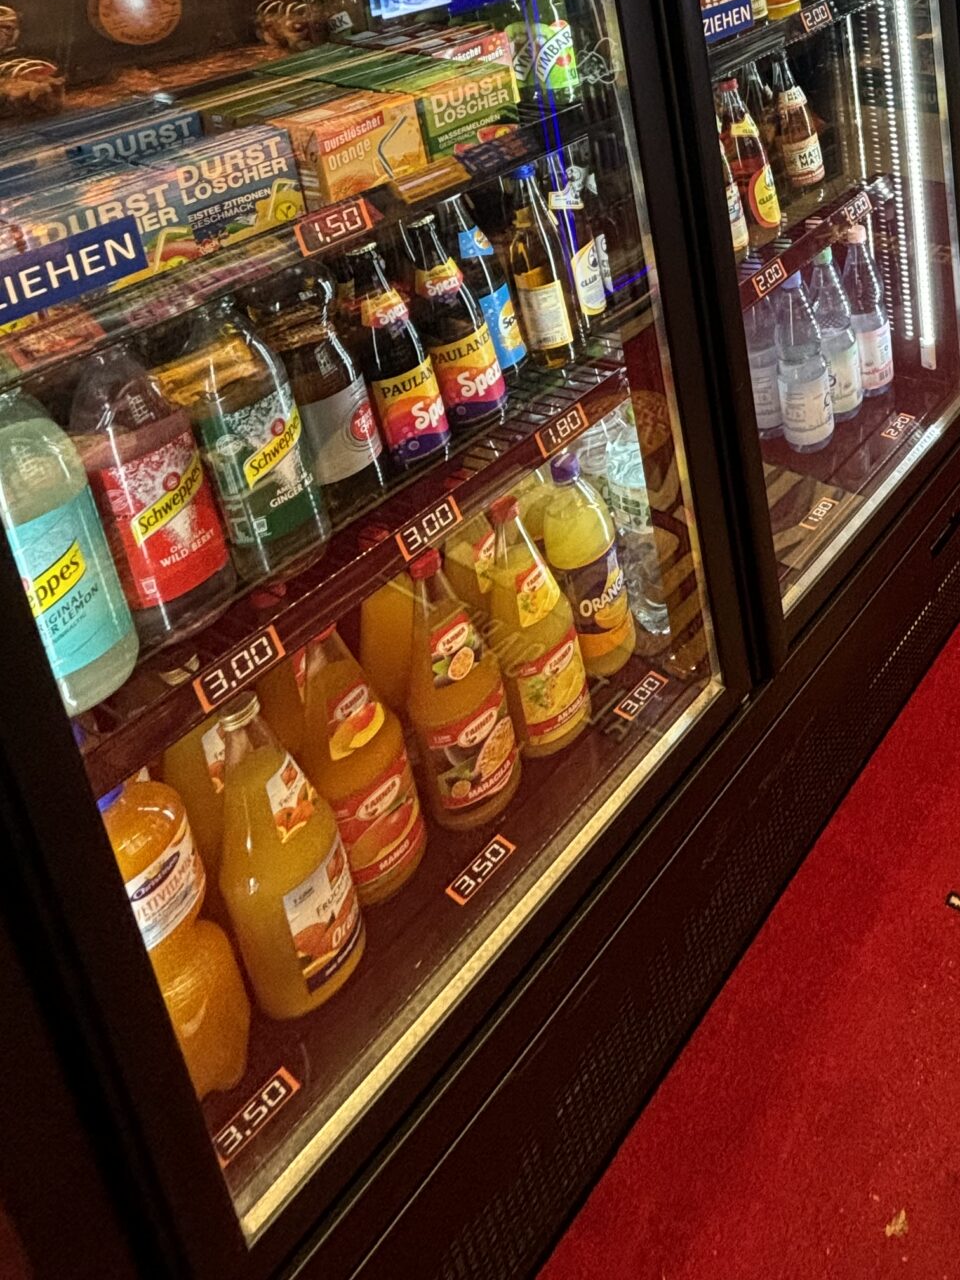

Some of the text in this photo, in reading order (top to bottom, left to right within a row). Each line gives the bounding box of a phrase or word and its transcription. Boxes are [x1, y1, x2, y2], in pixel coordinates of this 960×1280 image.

[702, 3, 752, 37] ZIEHEN
[537, 30, 573, 79] TYMBAR
[431, 72, 506, 114] DURST
[434, 89, 510, 129] LÖSCHER
[91, 117, 194, 162] DURST
[323, 114, 382, 153] Durstlöscher
[437, 114, 501, 144] WASSERMELONEN
[176, 136, 282, 190] DURST
[328, 137, 373, 171] Orange
[180, 157, 289, 206] LÖSCHER
[187, 206, 222, 224] EISTEE
[222, 187, 272, 213] ZITRONEN
[380, 366, 434, 401] PAULAN
[160, 528, 216, 569] WILD BERRY
[27, 557, 81, 610] eppes
[579, 570, 625, 618] ORANG
